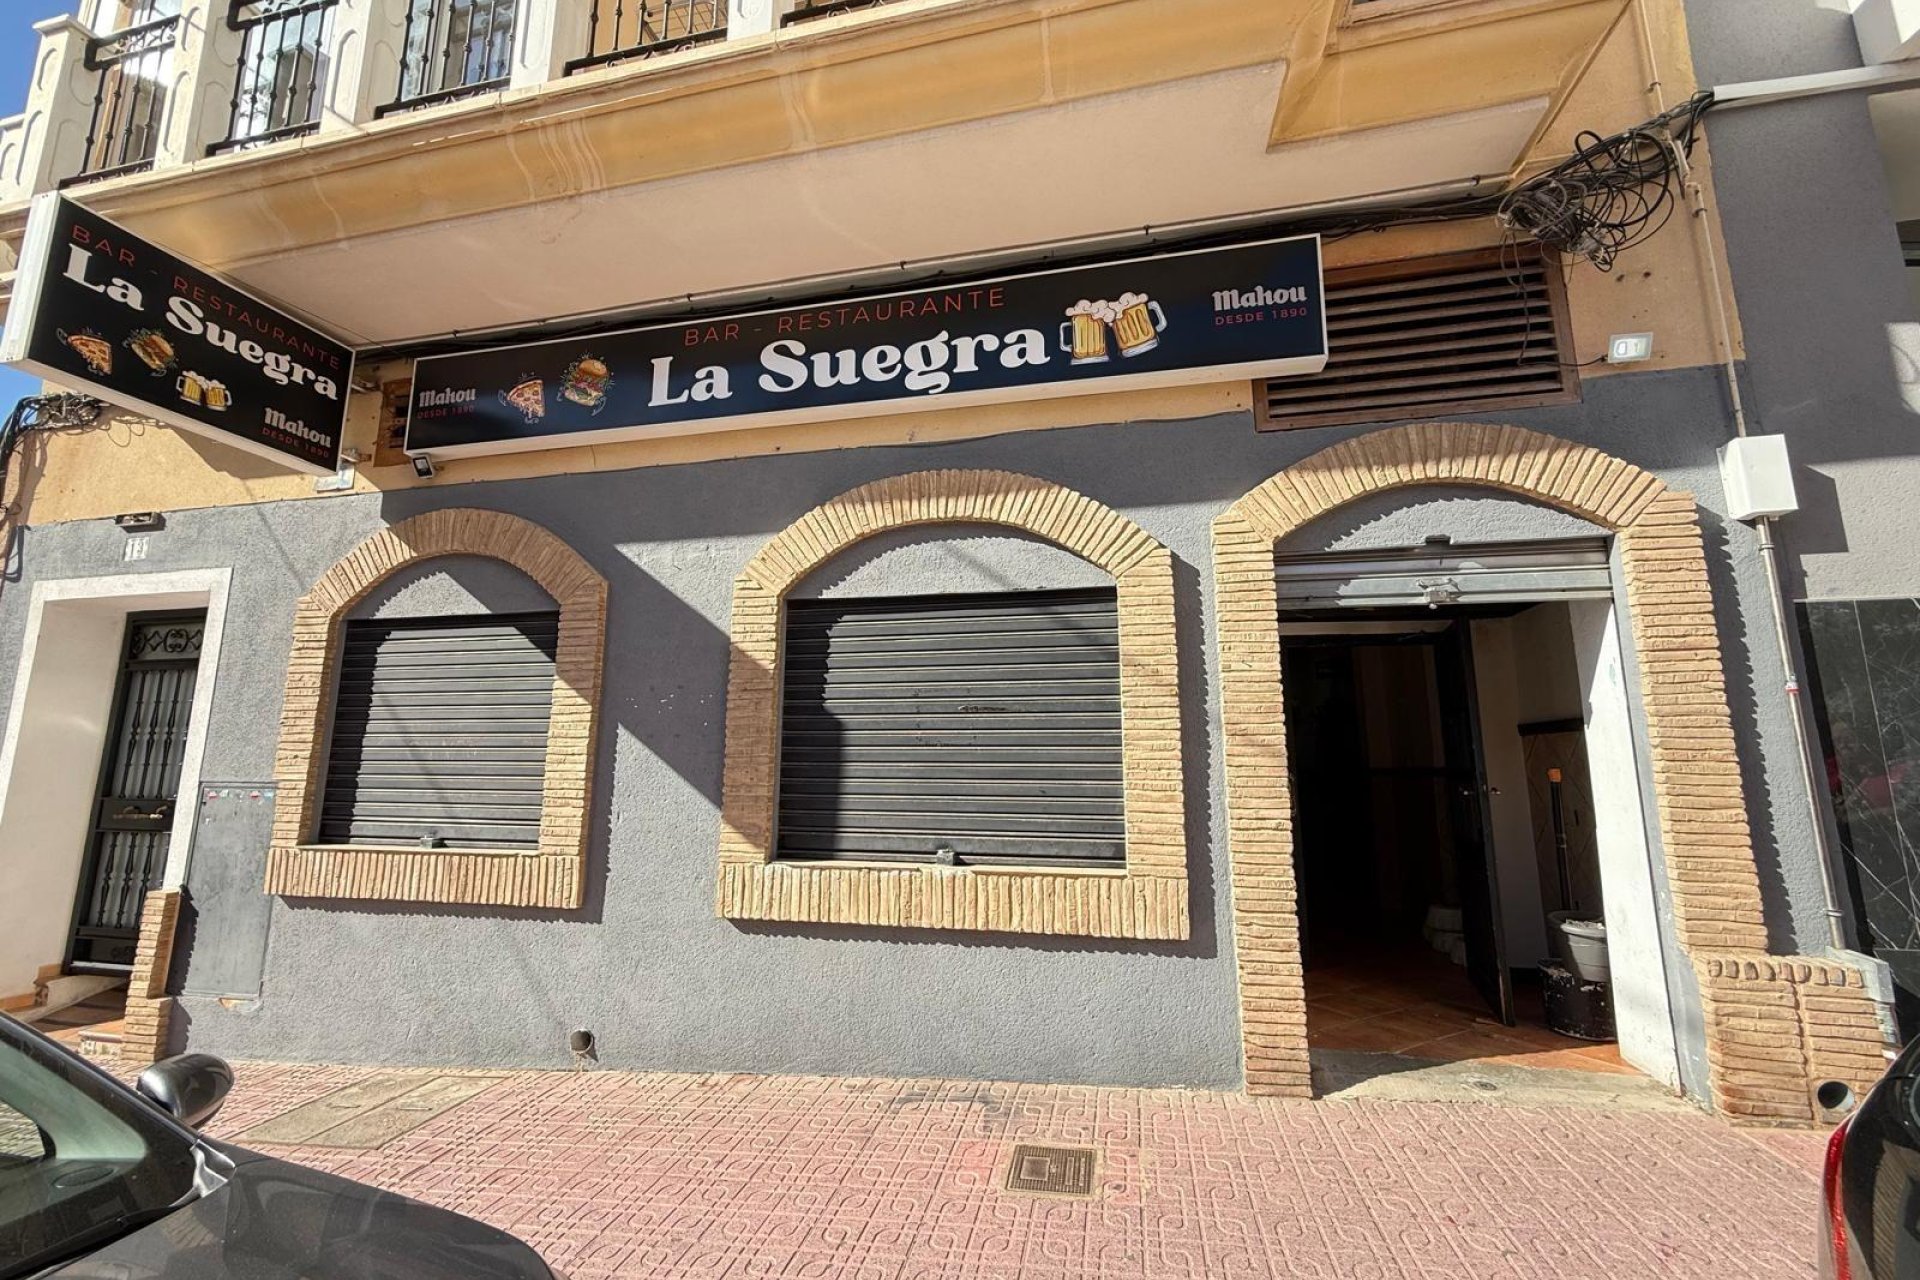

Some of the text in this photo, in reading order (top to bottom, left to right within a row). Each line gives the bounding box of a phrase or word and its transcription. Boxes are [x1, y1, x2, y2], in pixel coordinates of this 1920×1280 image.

[72, 224, 136, 267] BAR
[173, 276, 341, 370] RESTAURANTE
[1212, 285, 1307, 312] Mahou
[63, 243, 338, 400] La Suegra
[684, 323, 739, 346] BAR
[778, 288, 1005, 334] RESTAURANTE
[1215, 307, 1308, 325] DESDE 1890
[648, 327, 1050, 407] La Suegra
[417, 408, 447, 419] DESDE
[419, 387, 476, 407] Mahou
[262, 427, 299, 447] DESDE
[264, 407, 331, 448] Mahou
